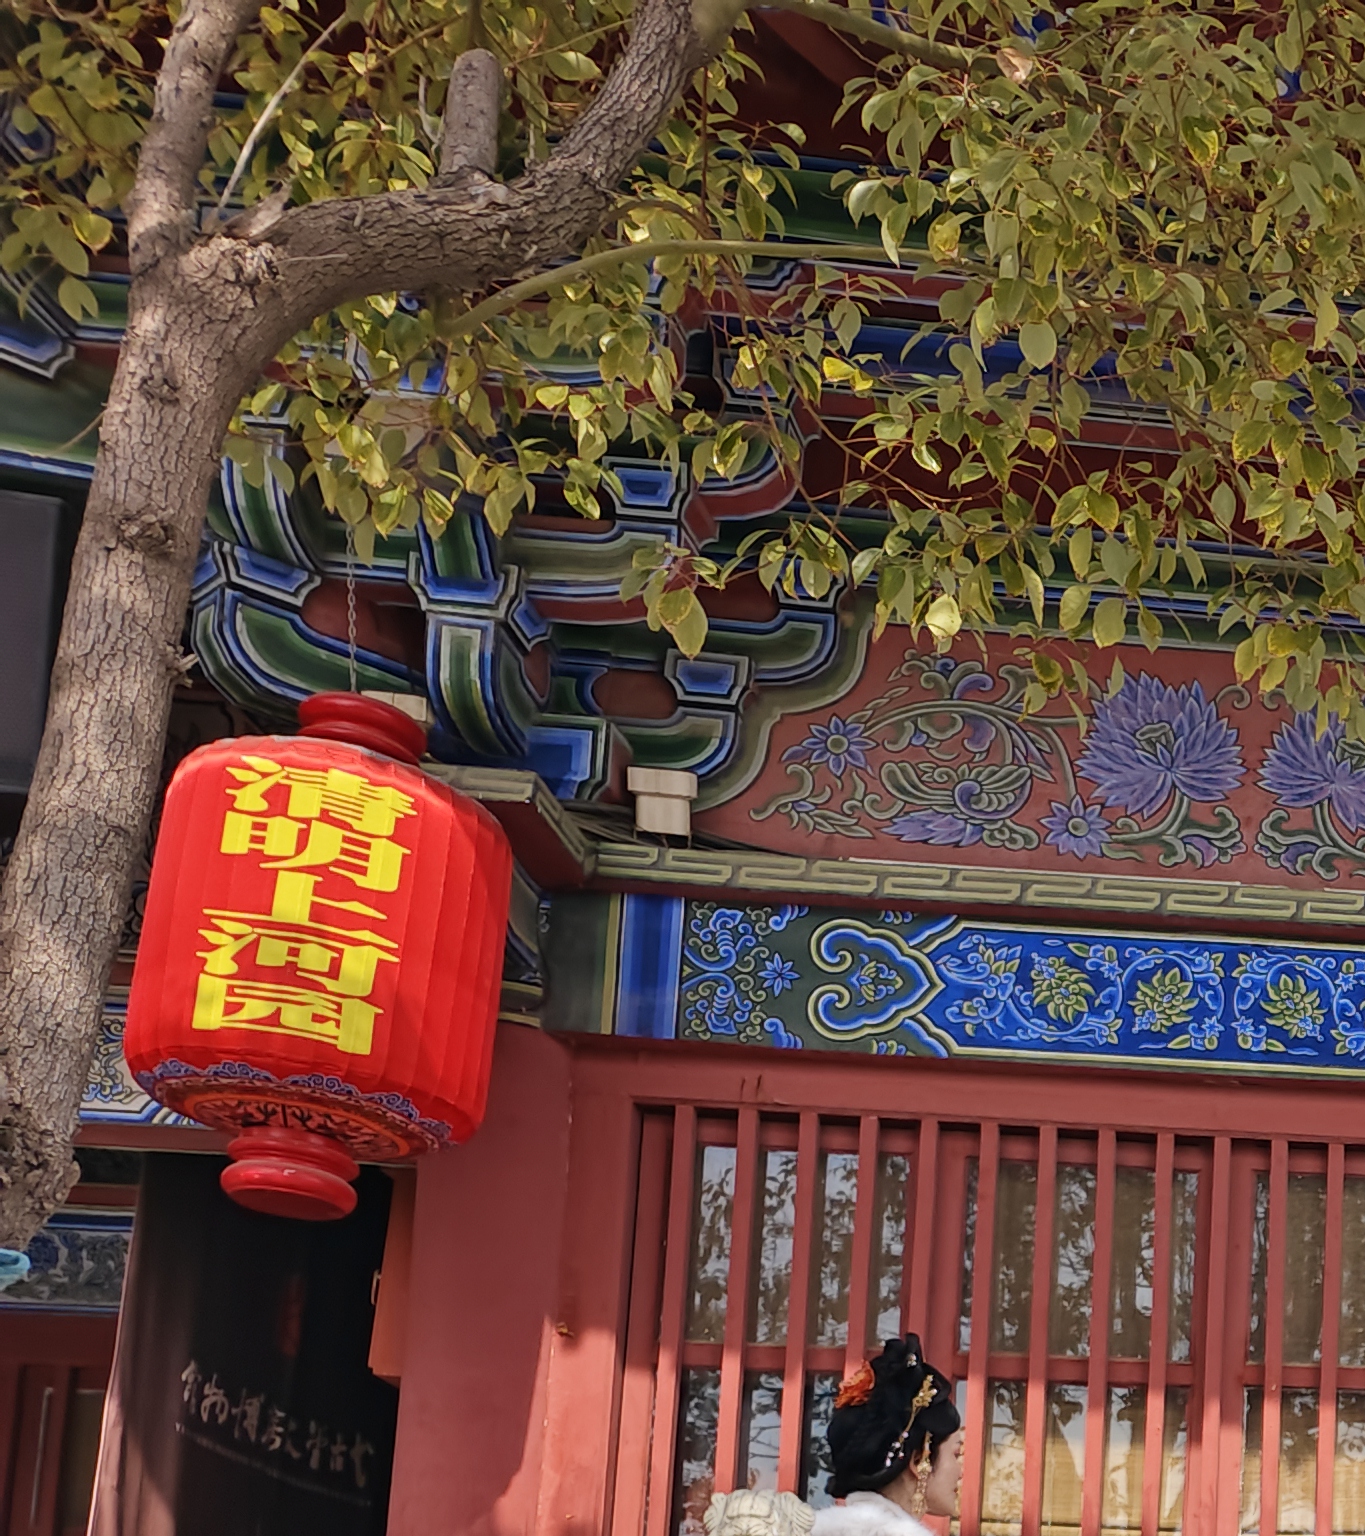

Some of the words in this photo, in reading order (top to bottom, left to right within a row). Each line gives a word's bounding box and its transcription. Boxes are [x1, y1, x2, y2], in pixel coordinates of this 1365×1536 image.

[191, 755, 417, 1057] 清明上河园
